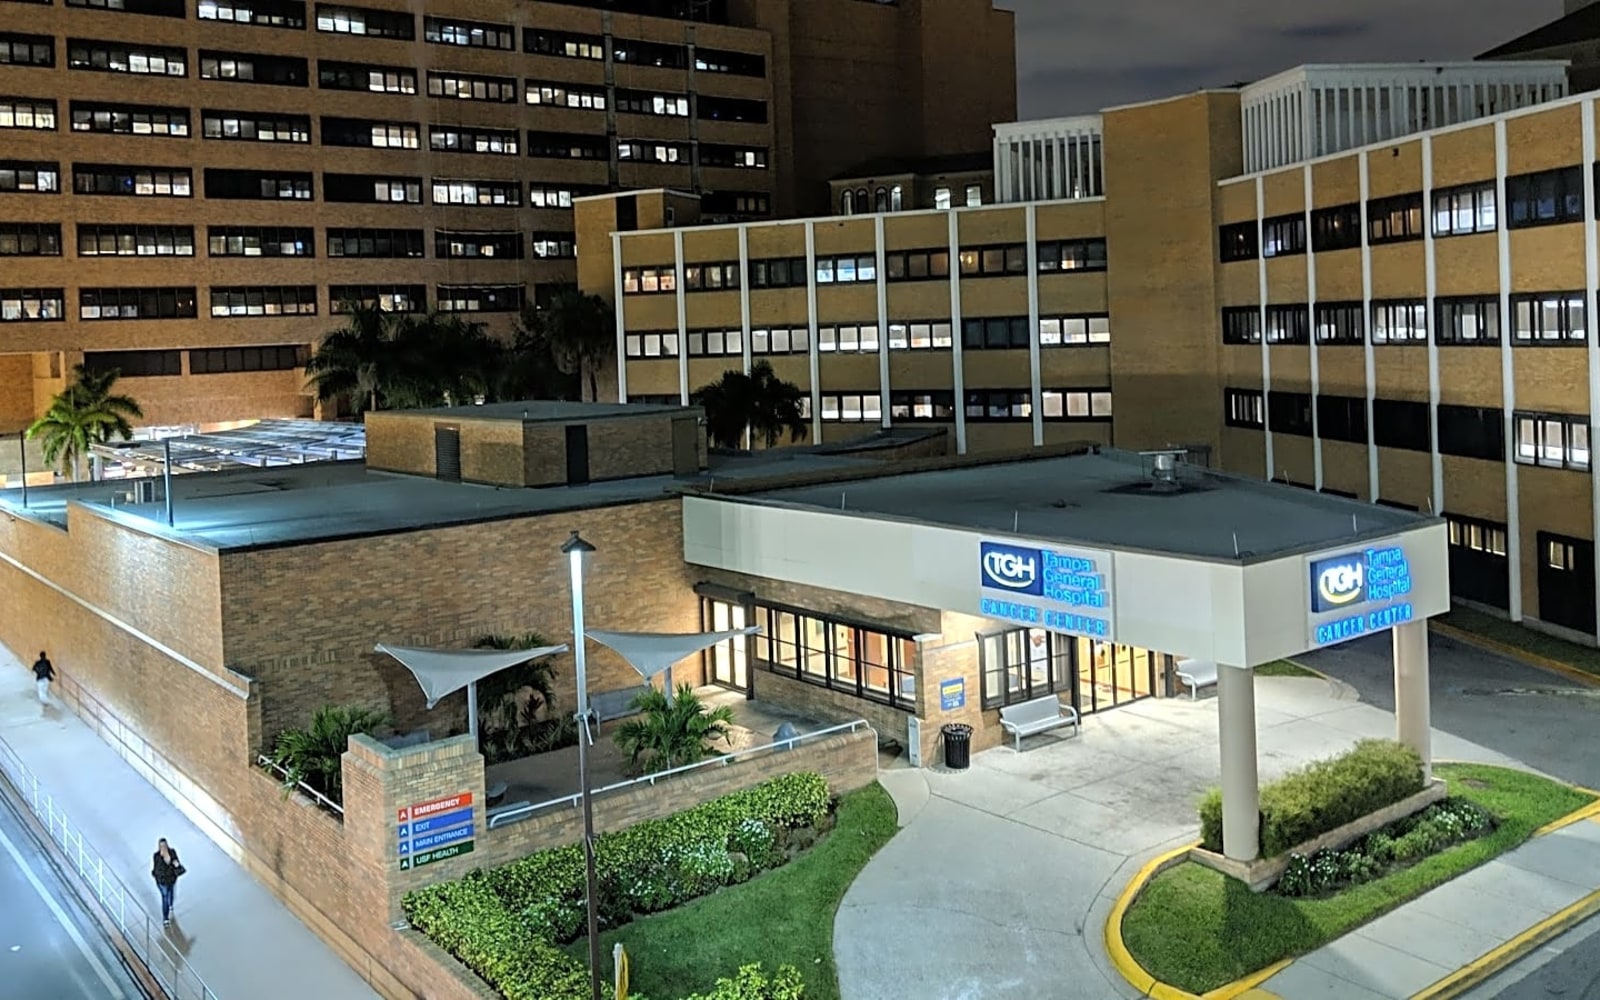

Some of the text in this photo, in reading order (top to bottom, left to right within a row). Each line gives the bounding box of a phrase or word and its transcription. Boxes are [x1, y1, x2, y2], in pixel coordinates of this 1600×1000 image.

[990, 551, 1035, 580] TGH
[1042, 550, 1092, 572] Tampa
[1367, 548, 1402, 566] Tampa
[1043, 567, 1101, 589] General
[1324, 562, 1363, 593] TGH
[1367, 560, 1408, 583] General
[1044, 584, 1104, 606] Hospital
[1368, 577, 1411, 600] Hospital
[981, 598, 1106, 635] CANCER CENTER
[1318, 604, 1412, 644] CANCER CENTER
[414, 798, 460, 815] EMERGENCY
[416, 822, 430, 832] EXIT
[416, 828, 468, 848] MAIN ENTRANCE
[416, 846, 458, 864] USF HEALTH
